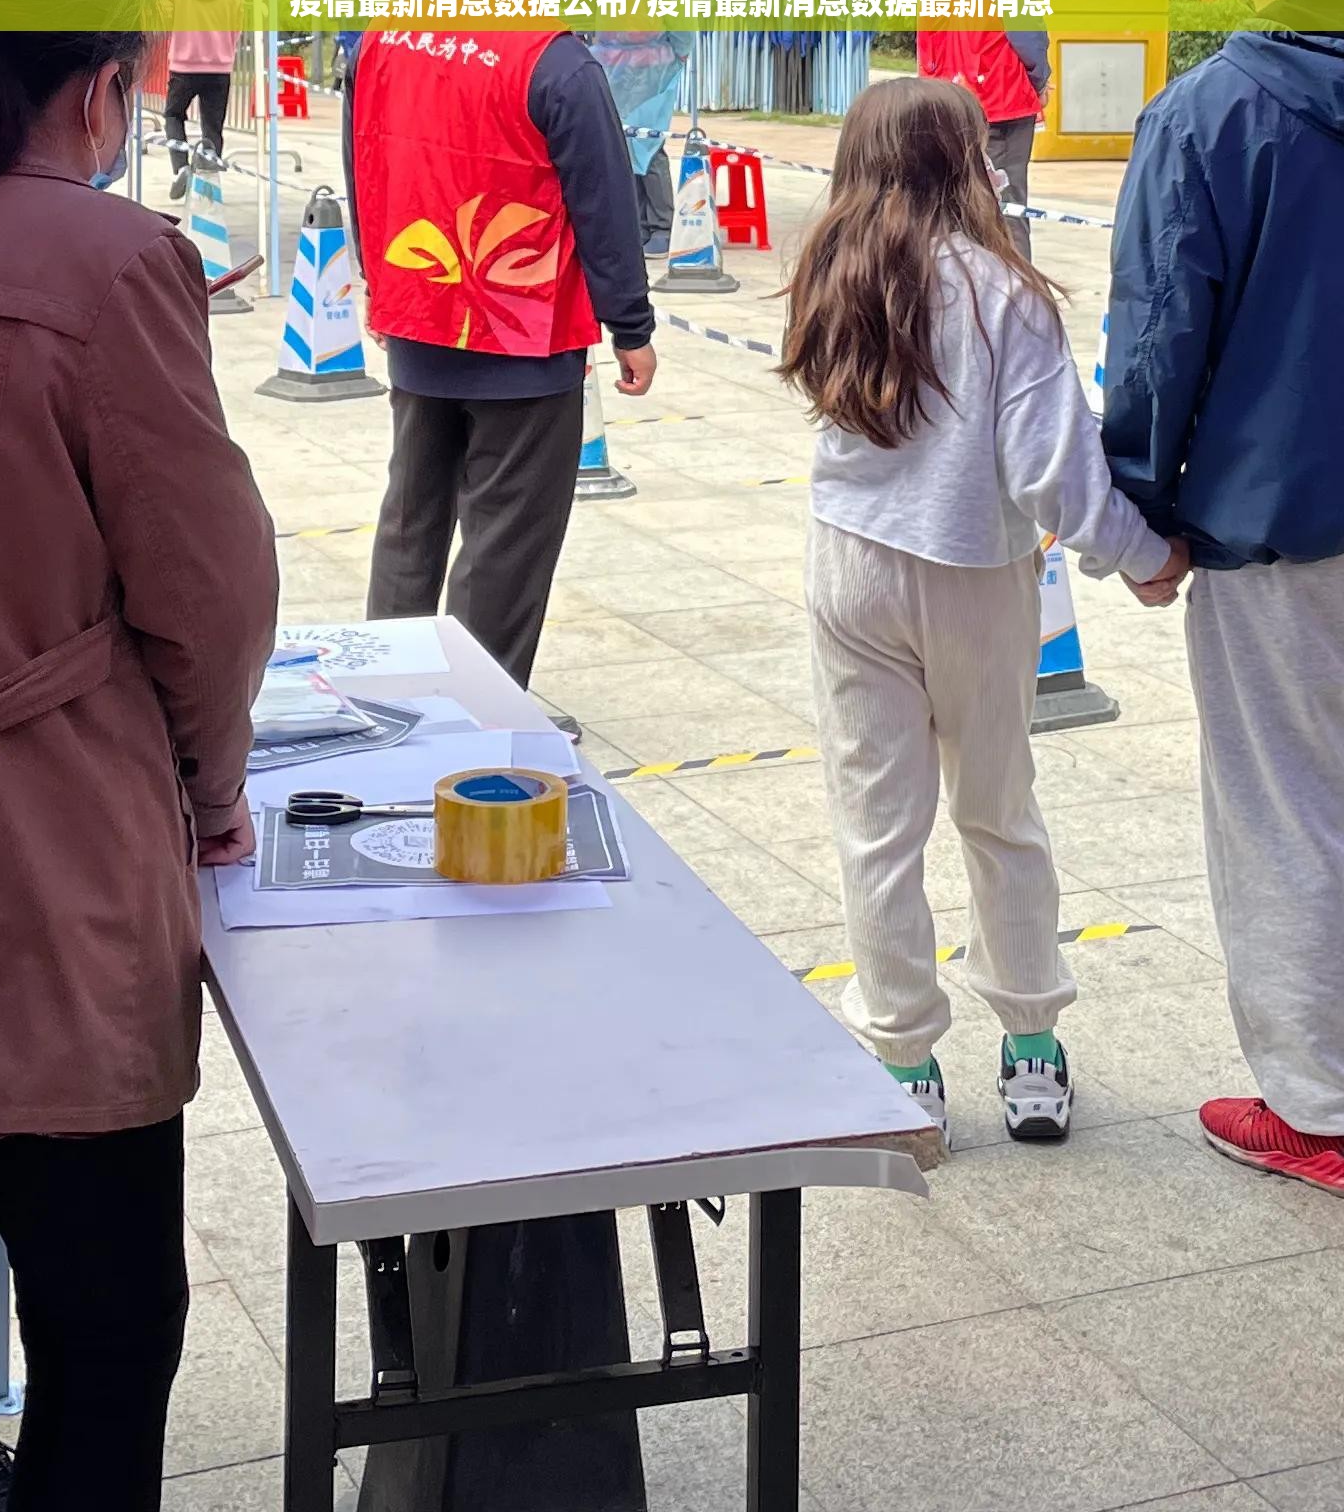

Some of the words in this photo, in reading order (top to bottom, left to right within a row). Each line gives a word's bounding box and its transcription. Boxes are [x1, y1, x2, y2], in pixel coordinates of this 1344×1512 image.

[379, 29, 501, 68] 以人民为中心
